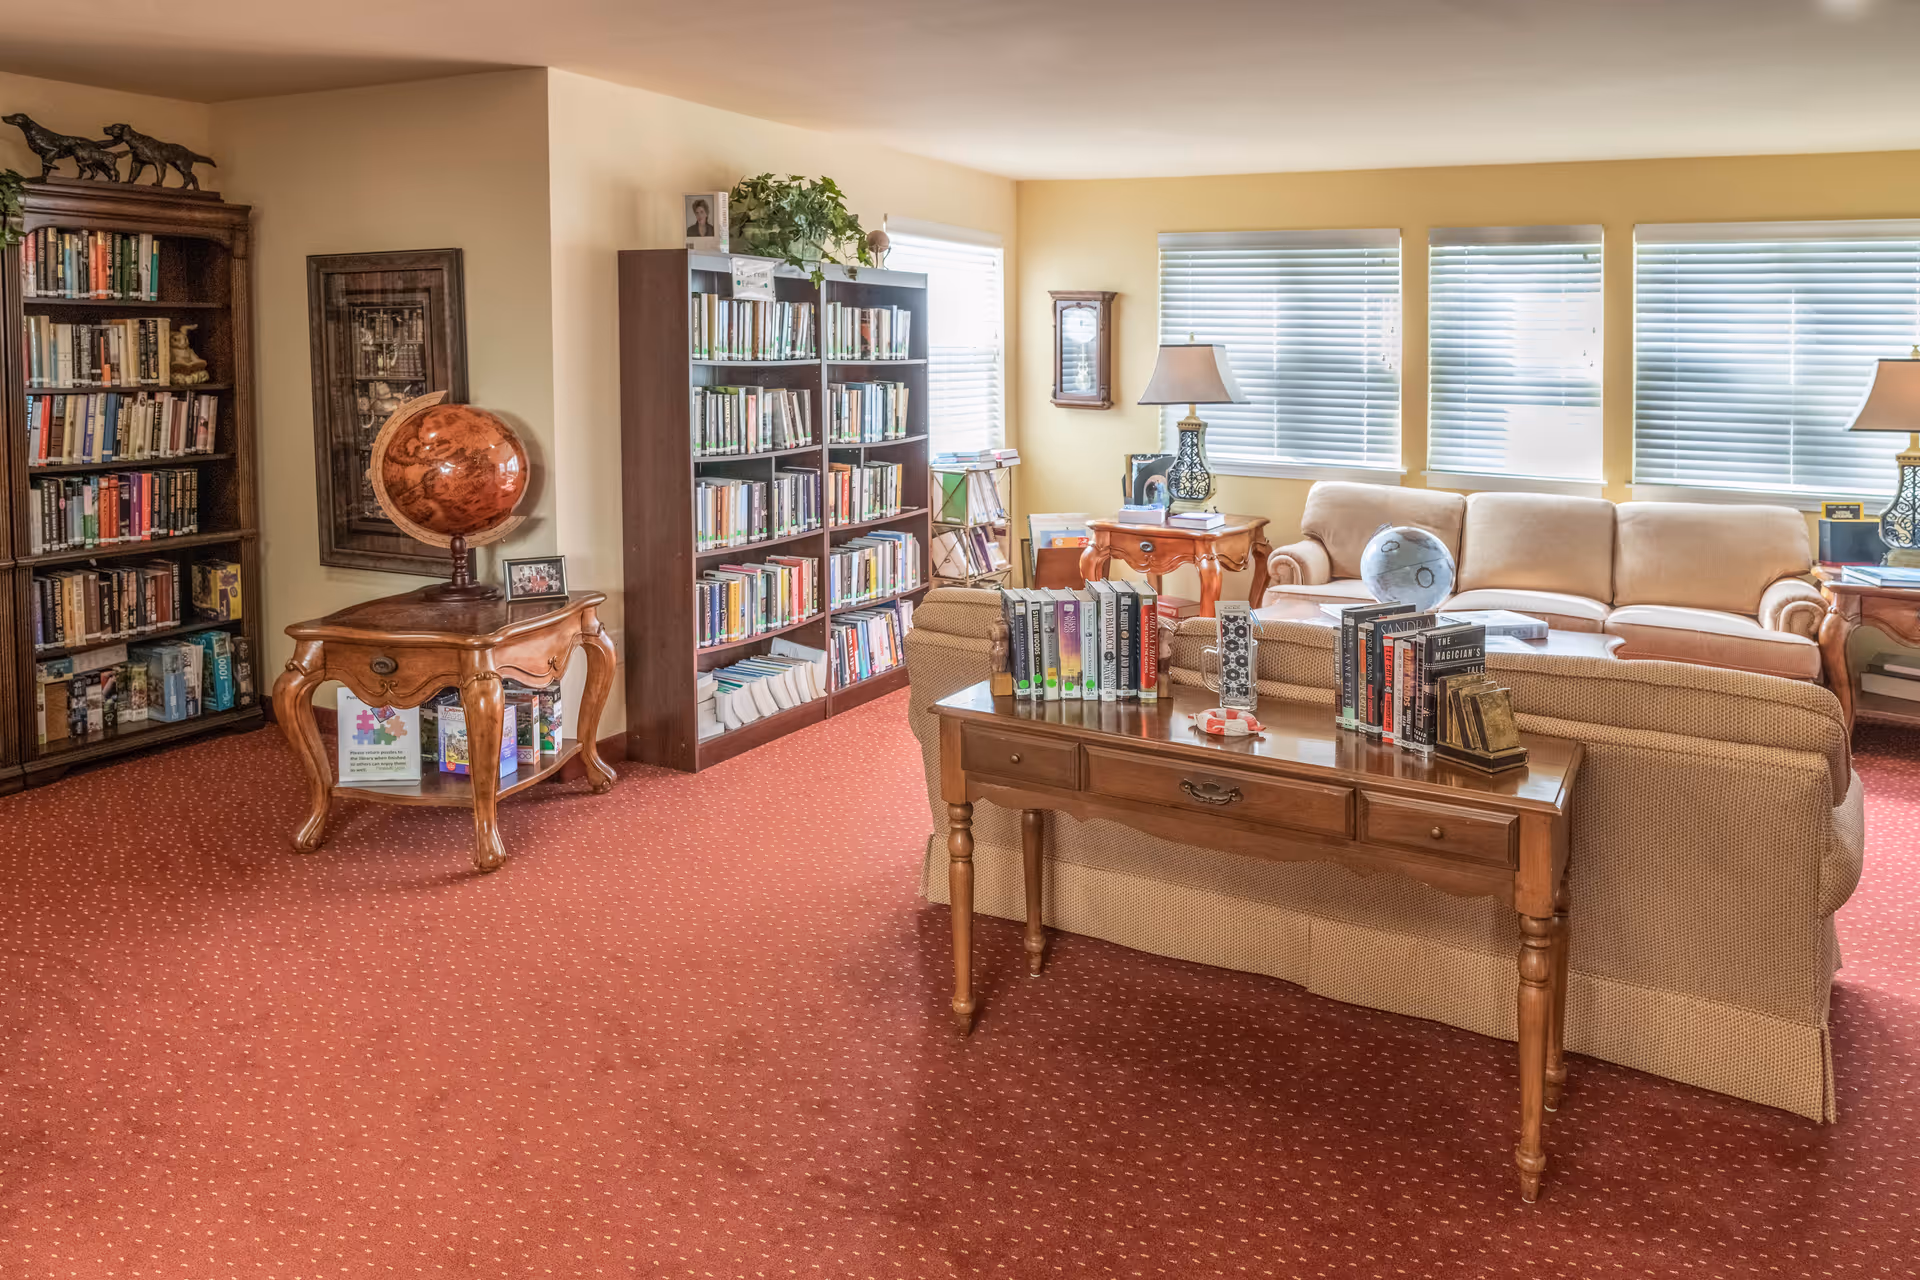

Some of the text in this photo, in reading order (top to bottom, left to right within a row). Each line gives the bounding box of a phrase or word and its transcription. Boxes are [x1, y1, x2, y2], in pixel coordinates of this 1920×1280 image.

[1381, 618, 1435, 634] SANDRA
[1121, 639, 1129, 655] BLOOD
[1438, 637, 1450, 646] THE
[1435, 648, 1480, 660] MAGICIAN'S
[1121, 656, 1129, 666] AND
[218, 659, 228, 680] 1000
[1467, 665, 1485, 675] TALE
